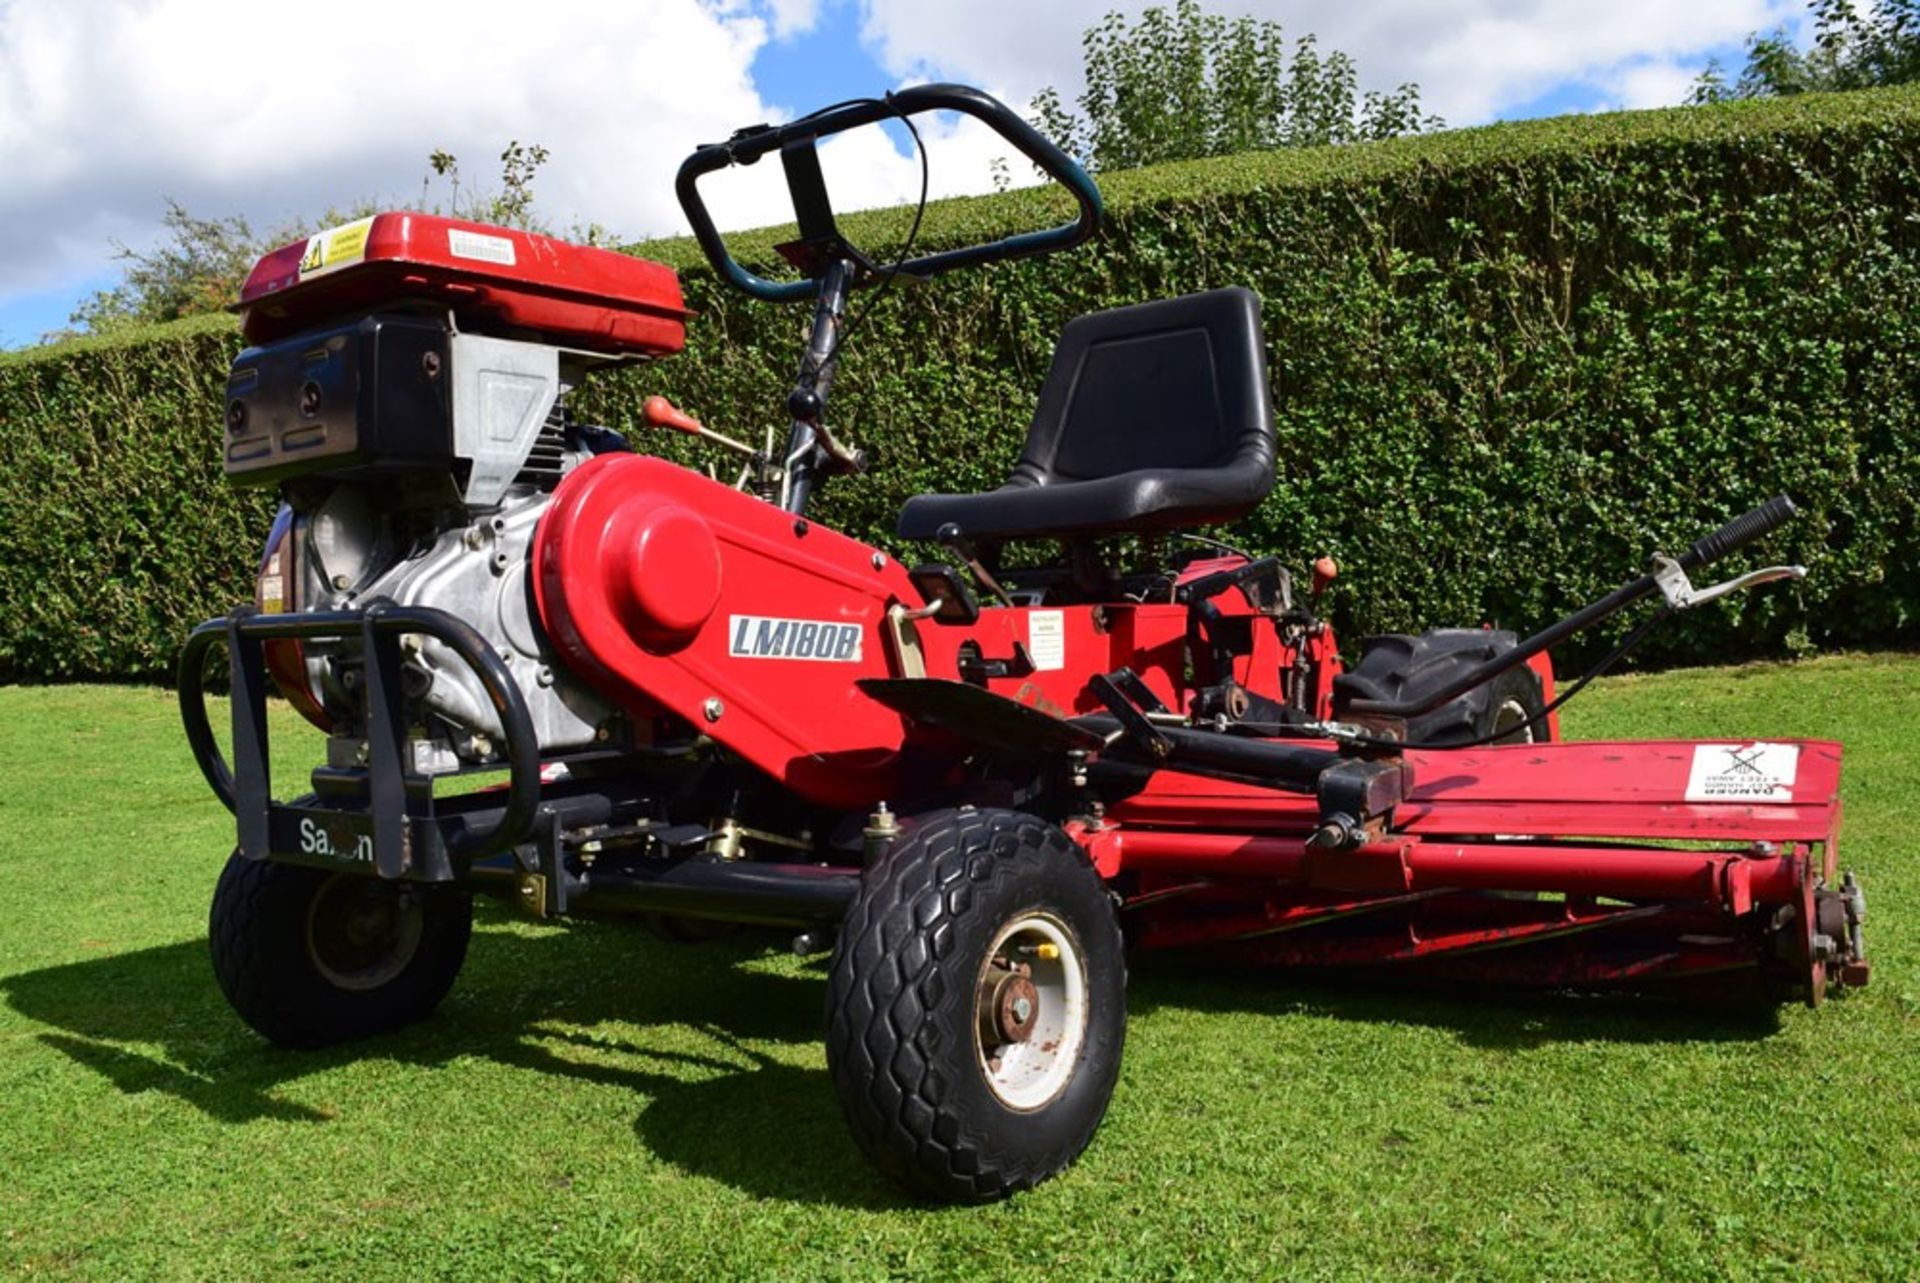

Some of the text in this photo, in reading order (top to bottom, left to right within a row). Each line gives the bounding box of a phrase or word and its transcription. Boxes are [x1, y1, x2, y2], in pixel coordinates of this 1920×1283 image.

[732, 618, 860, 659] LM180B
[1704, 787, 1774, 795] DANGER
[300, 817, 374, 862] San
